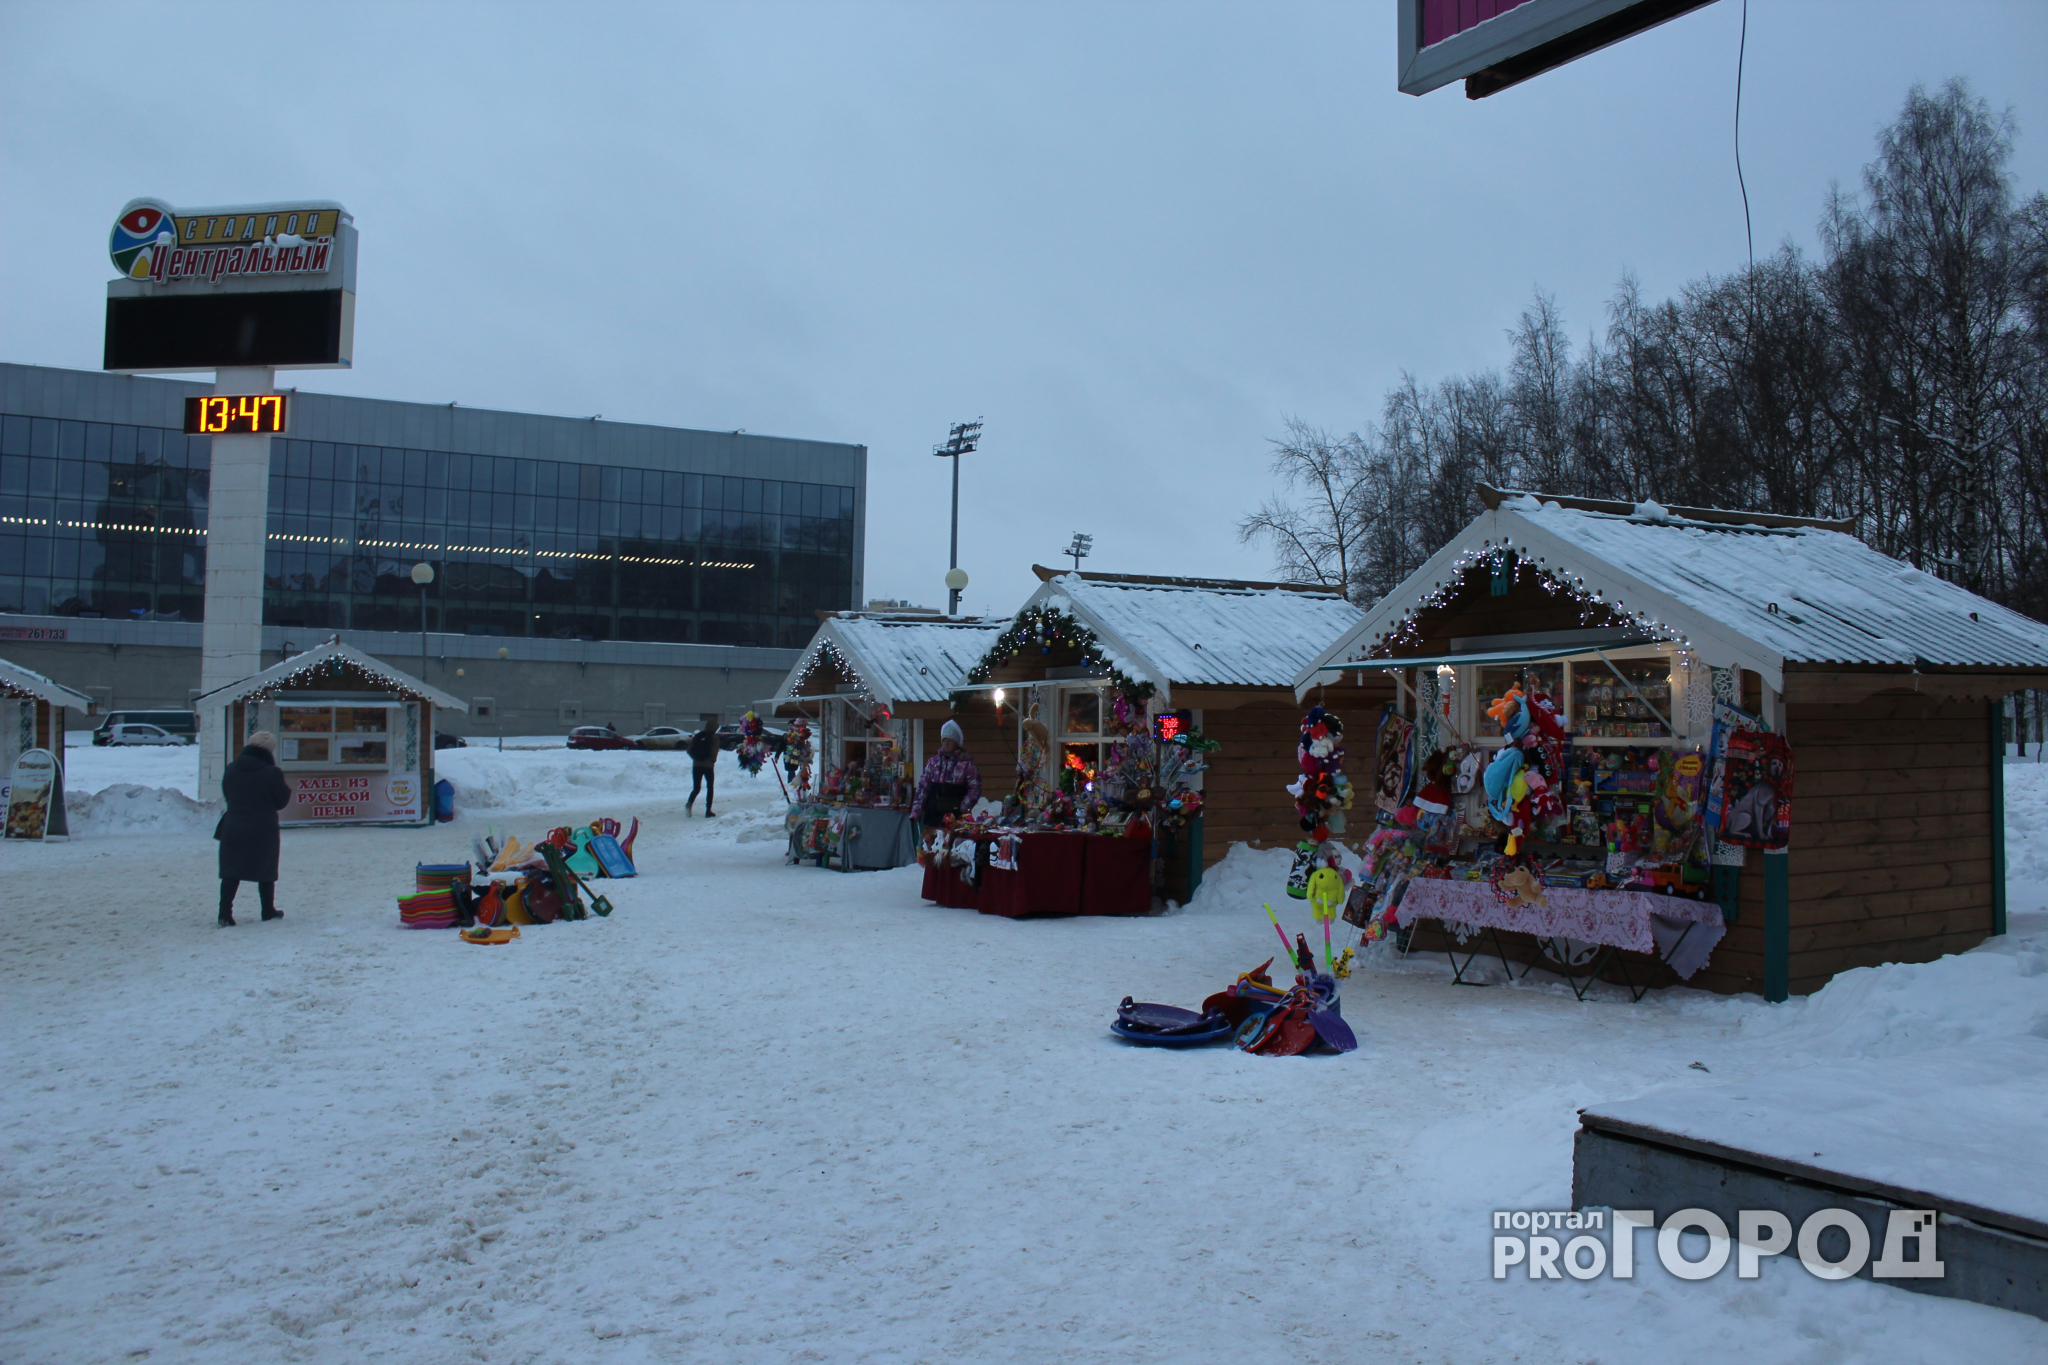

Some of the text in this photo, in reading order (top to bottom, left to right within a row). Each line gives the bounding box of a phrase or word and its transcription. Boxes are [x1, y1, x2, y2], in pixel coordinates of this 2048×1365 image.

[185, 213, 321, 240] СТАДИОН
[148, 237, 333, 283] Центральный
[200, 396, 282, 432] 13:47
[27, 628, 65, 640] 261-733
[299, 778, 369, 790] ХЛЕБ ИЗ
[298, 790, 370, 803] РУССКОЙ
[313, 806, 355, 817] ПЕЧИ
